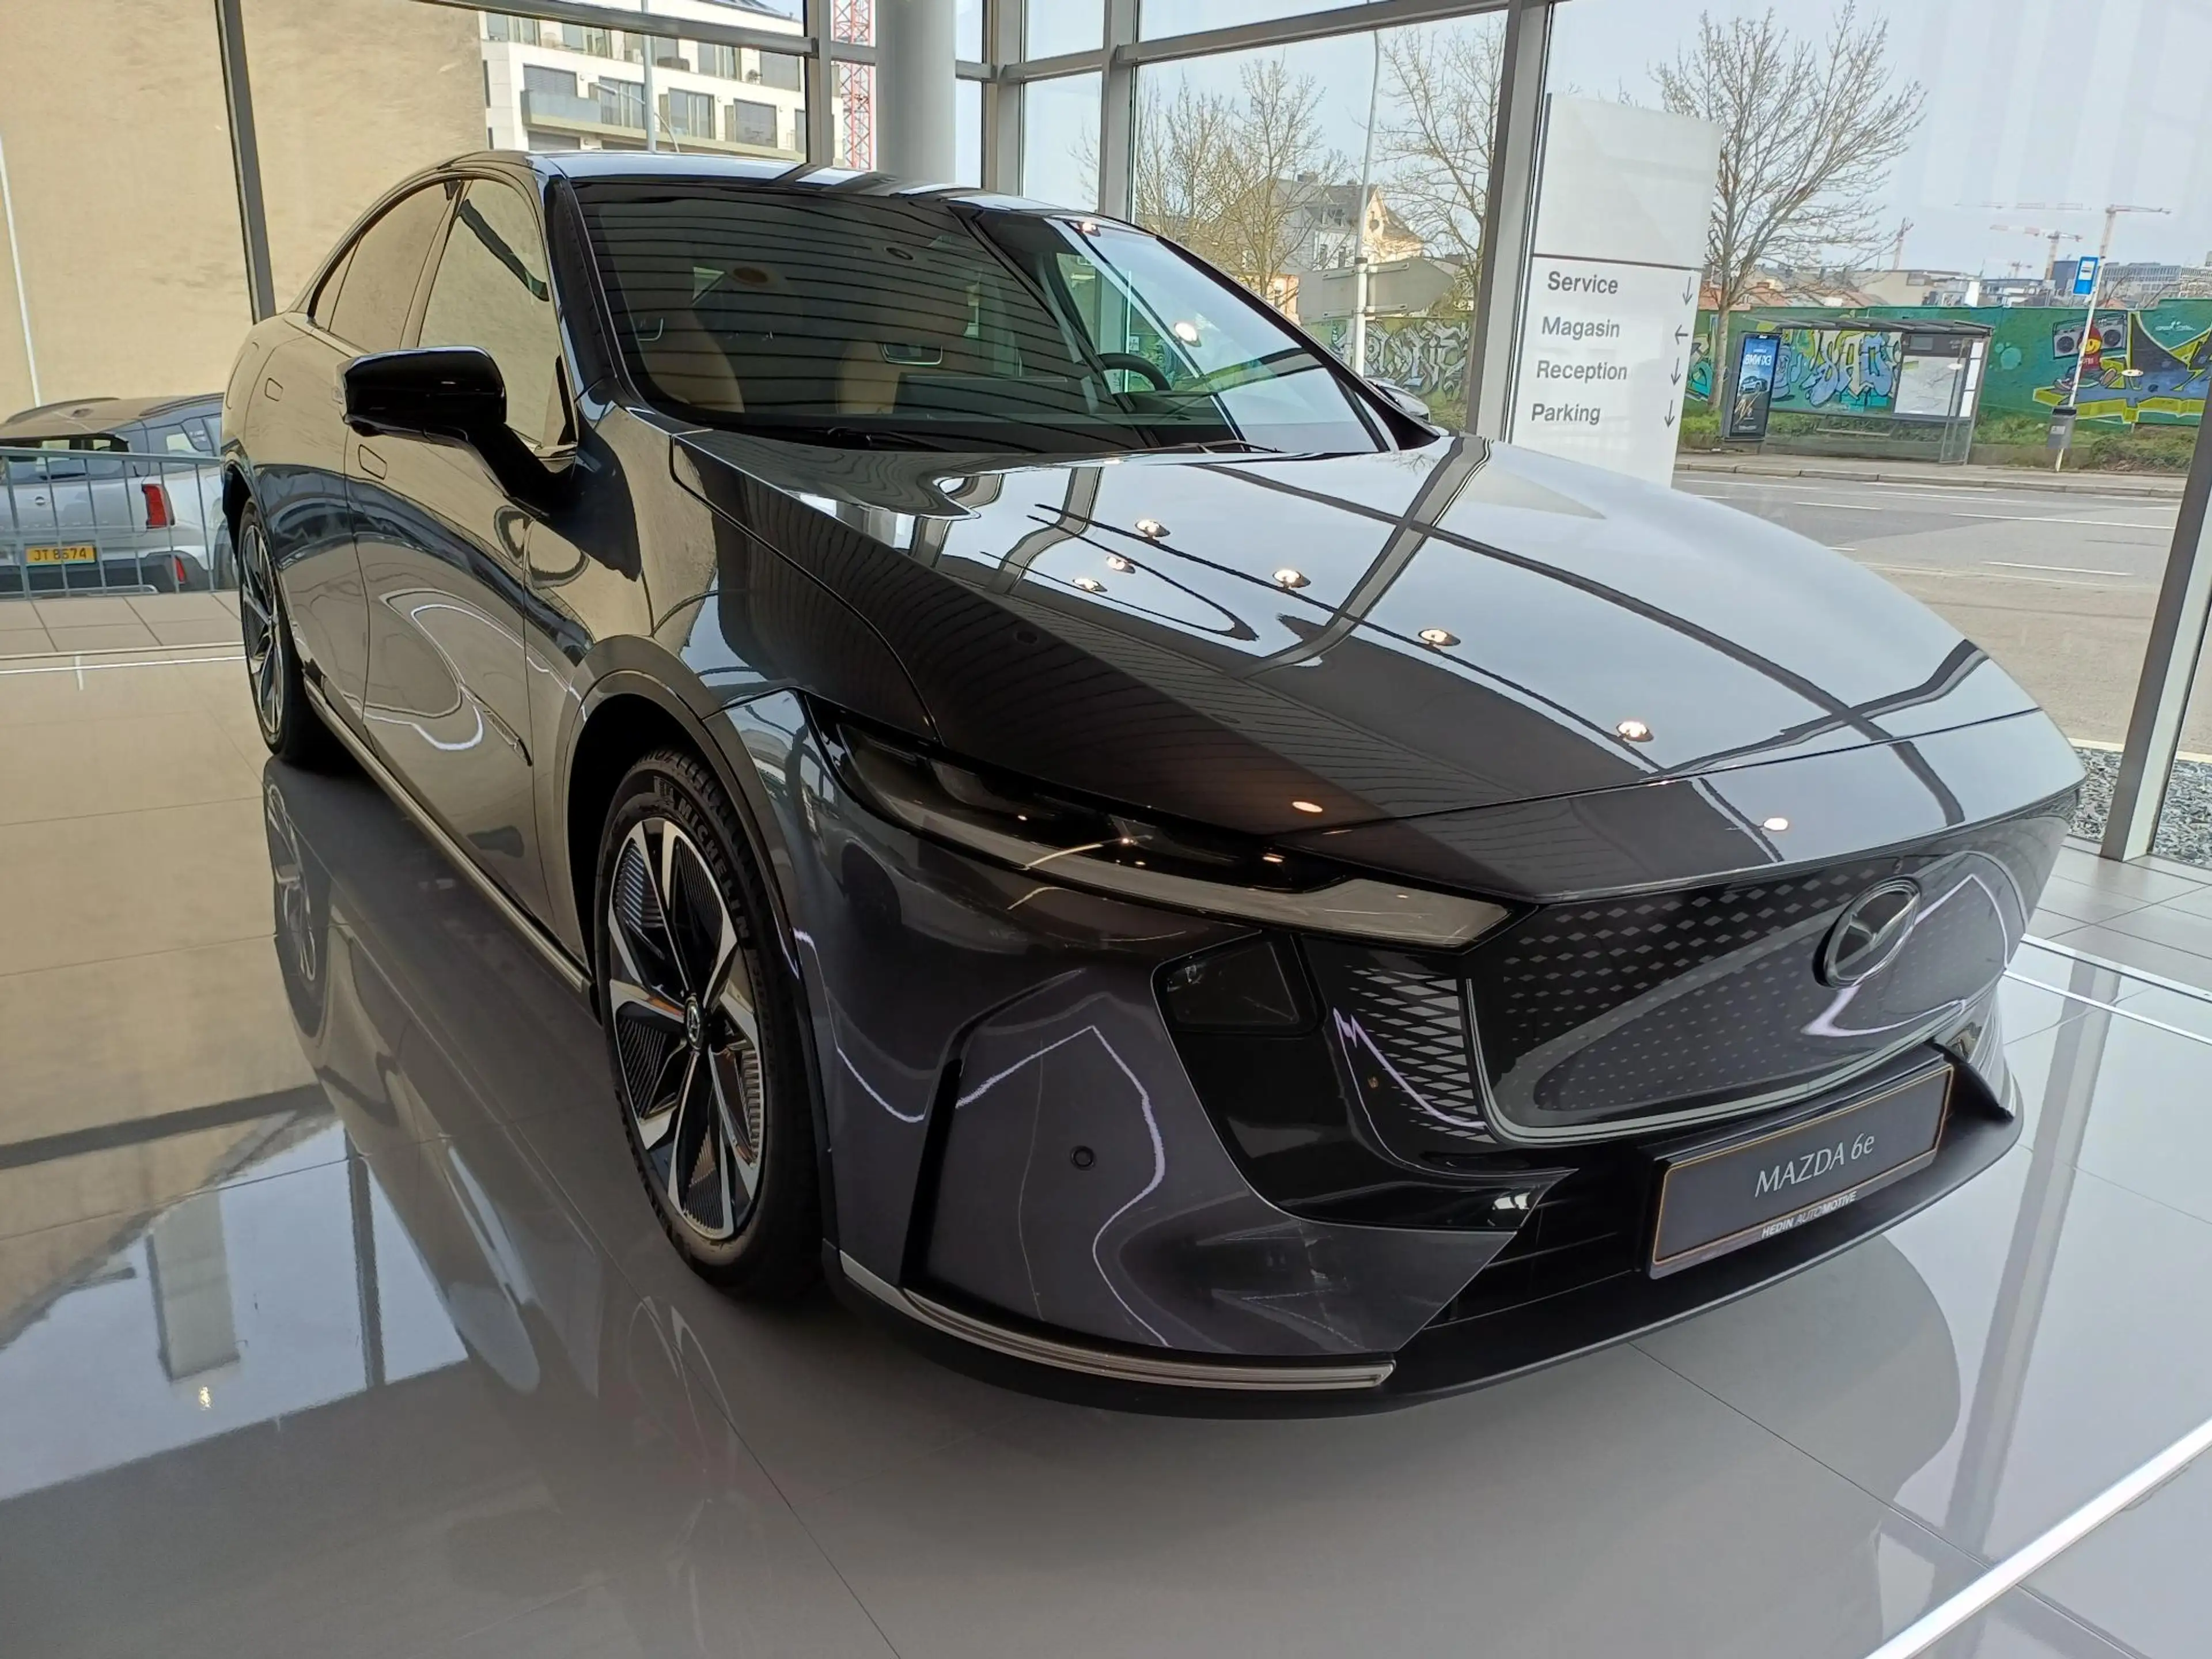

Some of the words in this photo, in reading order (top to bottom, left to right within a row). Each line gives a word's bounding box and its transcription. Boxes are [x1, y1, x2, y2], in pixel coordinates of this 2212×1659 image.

[1547, 271, 1618, 294] Service
[1541, 316, 1620, 340] Magasin
[1536, 360, 1627, 384] Reception
[1531, 403, 1601, 425] Parking
[34, 550, 48, 561] JT
[678, 797, 750, 939] MICHELIN
[1755, 1141, 1845, 1198] MAZDA
[1850, 1132, 1875, 1160] 6e
[1761, 1217, 1794, 1239] HEDIN
[1795, 1191, 1858, 1226] AUTOMOTIVE
